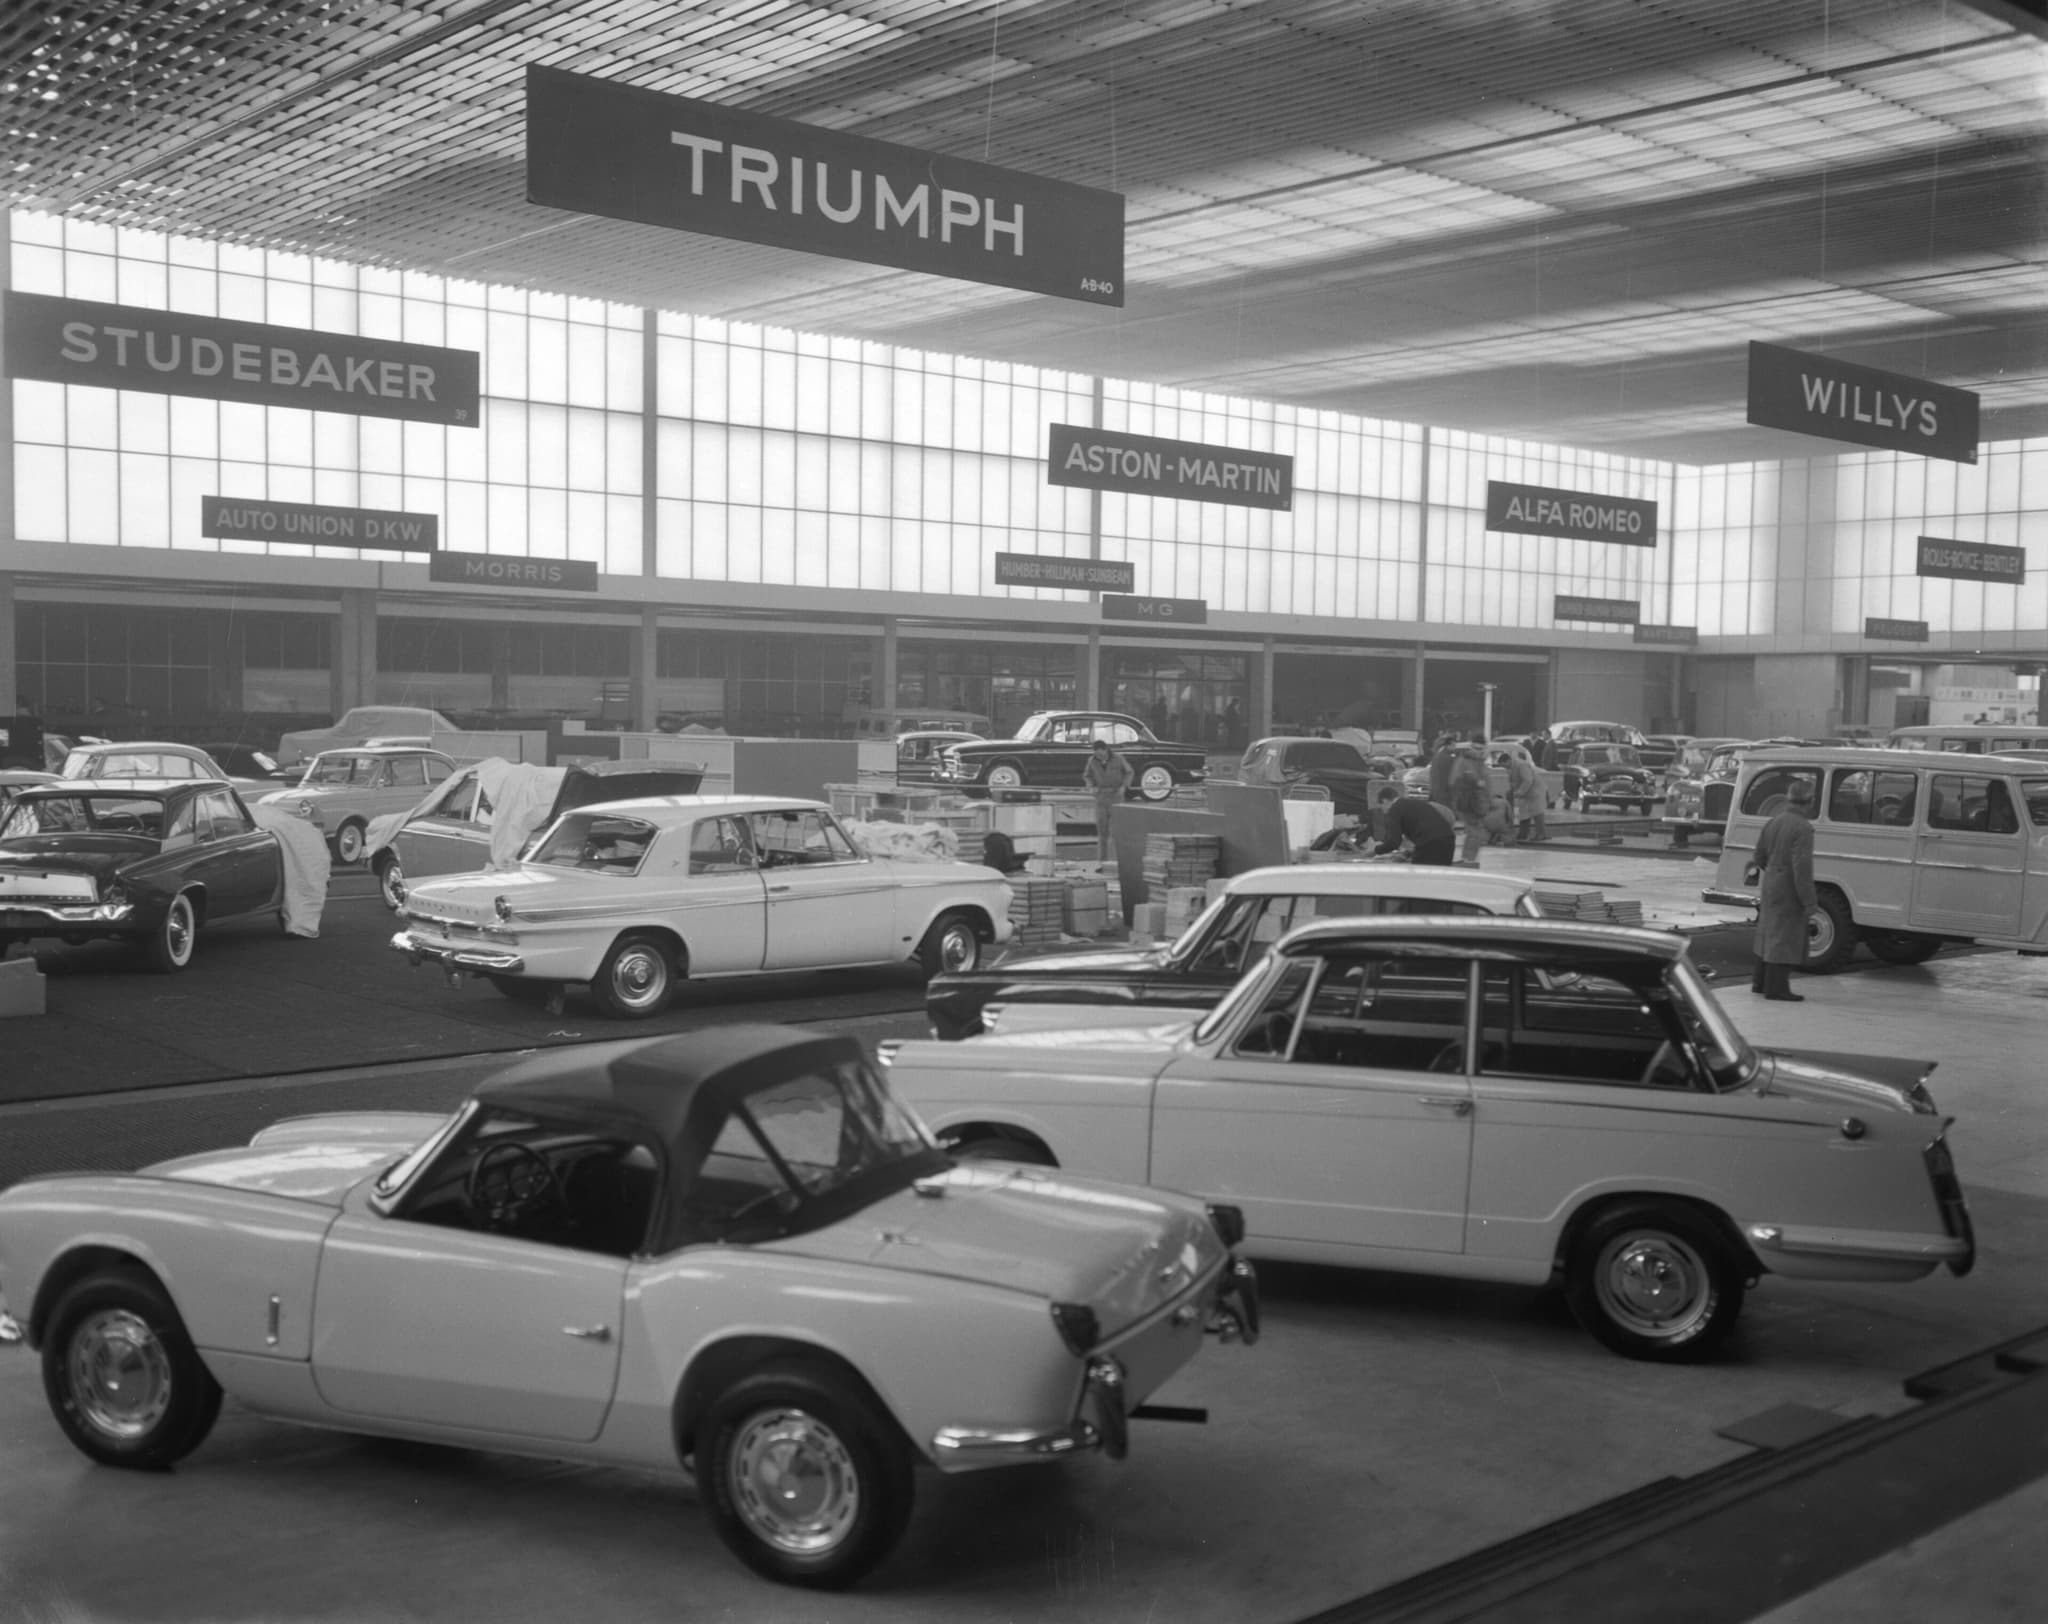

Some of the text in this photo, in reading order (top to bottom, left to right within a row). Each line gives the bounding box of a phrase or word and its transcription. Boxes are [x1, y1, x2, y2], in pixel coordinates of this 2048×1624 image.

[670, 130, 1024, 256] TRIUMPH
[61, 322, 437, 402] STUDEBAKER
[1801, 373, 1938, 436] WILLYS
[215, 507, 423, 541] AUTO UNION DKW
[1505, 496, 1642, 533] ALFA ROMEO
[465, 560, 562, 582] MORRIS
